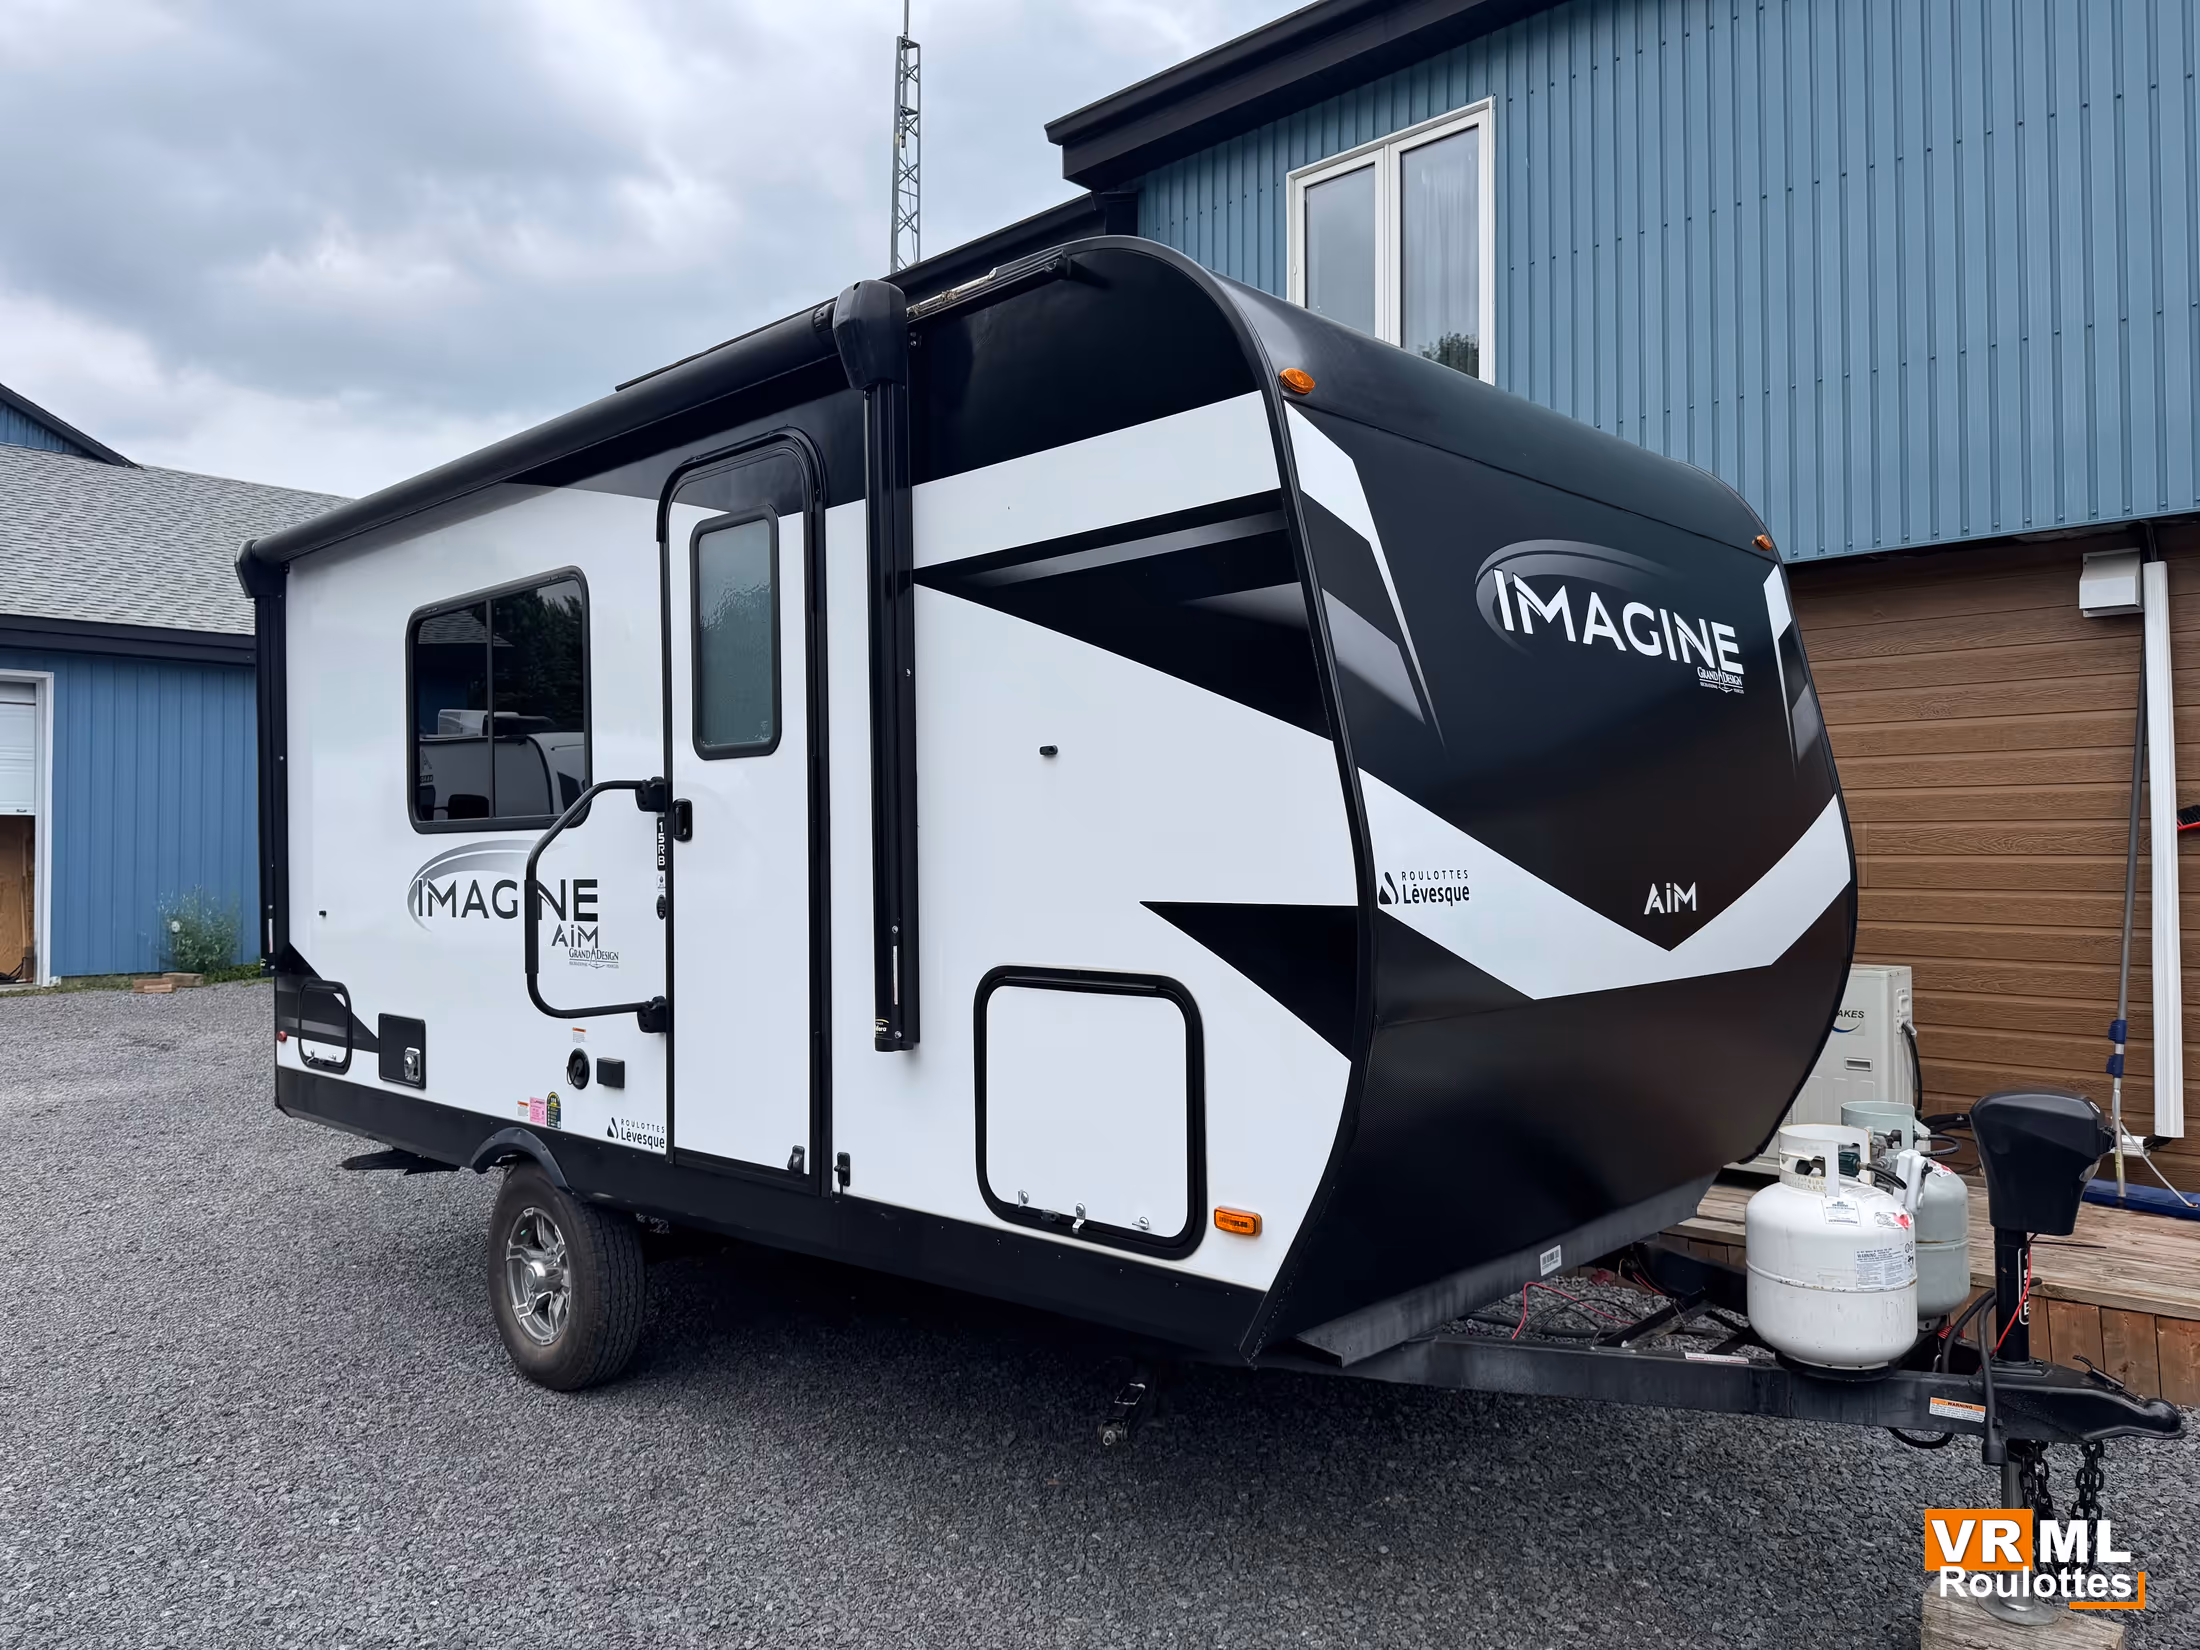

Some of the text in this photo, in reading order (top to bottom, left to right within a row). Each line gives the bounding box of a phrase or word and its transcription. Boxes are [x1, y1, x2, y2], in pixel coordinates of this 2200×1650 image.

[1493, 568, 1744, 675] IMAGINE
[1697, 666, 1718, 681] GRAND
[1722, 671, 1743, 686] DESIGN
[657, 821, 666, 866] 15RB
[1401, 869, 1469, 881] ROULOTTES
[417, 878, 599, 922] IMAGNE
[1402, 883, 1470, 907] Lévesque
[569, 947, 619, 961] GRAND DESIGN
[1836, 1009, 1865, 1019] AKES
[620, 1118, 665, 1134] ROULOTTES
[621, 1127, 665, 1150] Lévesque
